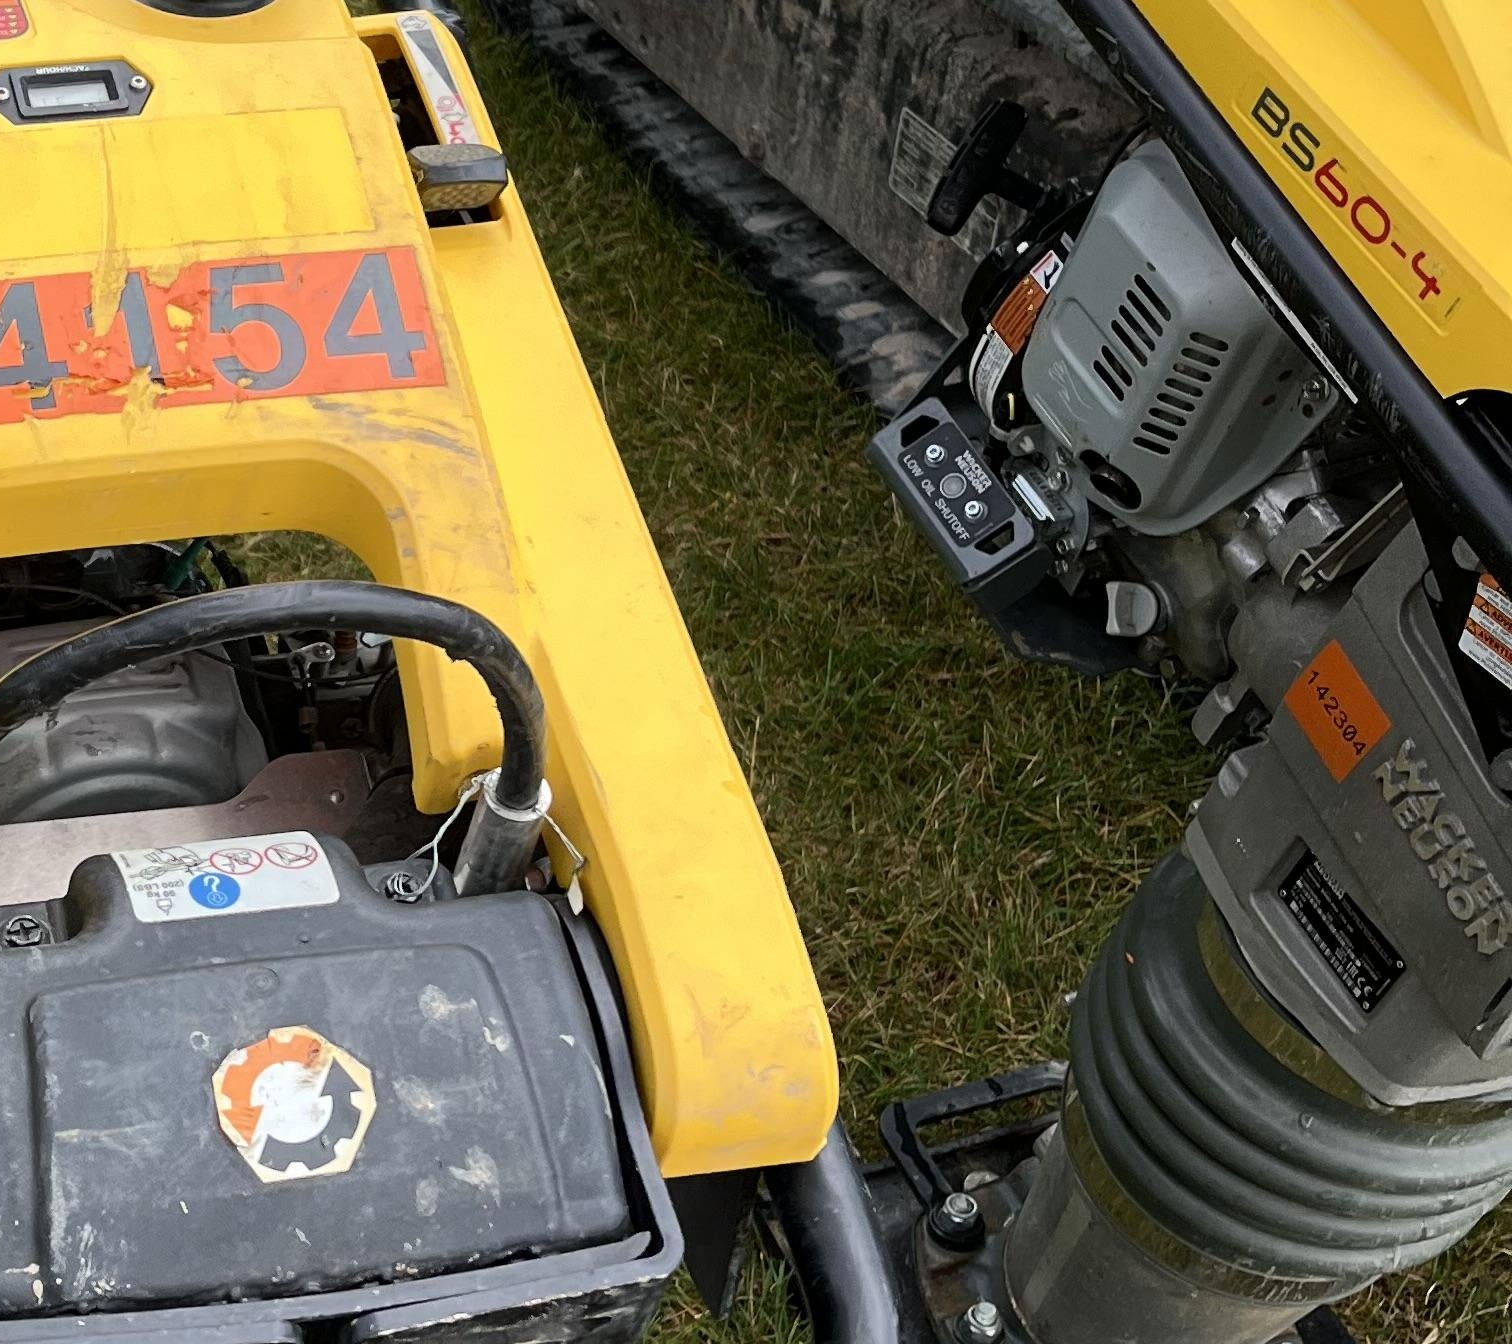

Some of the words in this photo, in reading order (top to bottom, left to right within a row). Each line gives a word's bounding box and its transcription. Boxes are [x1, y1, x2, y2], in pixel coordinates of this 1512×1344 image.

[1251, 86, 1441, 300] BS60-4
[903, 454, 924, 477] LOW
[921, 479, 936, 497] OIL
[934, 498, 970, 541] SHUTOFF
[955, 455, 986, 495] NEUSON
[1306, 669, 1368, 757] 142304
